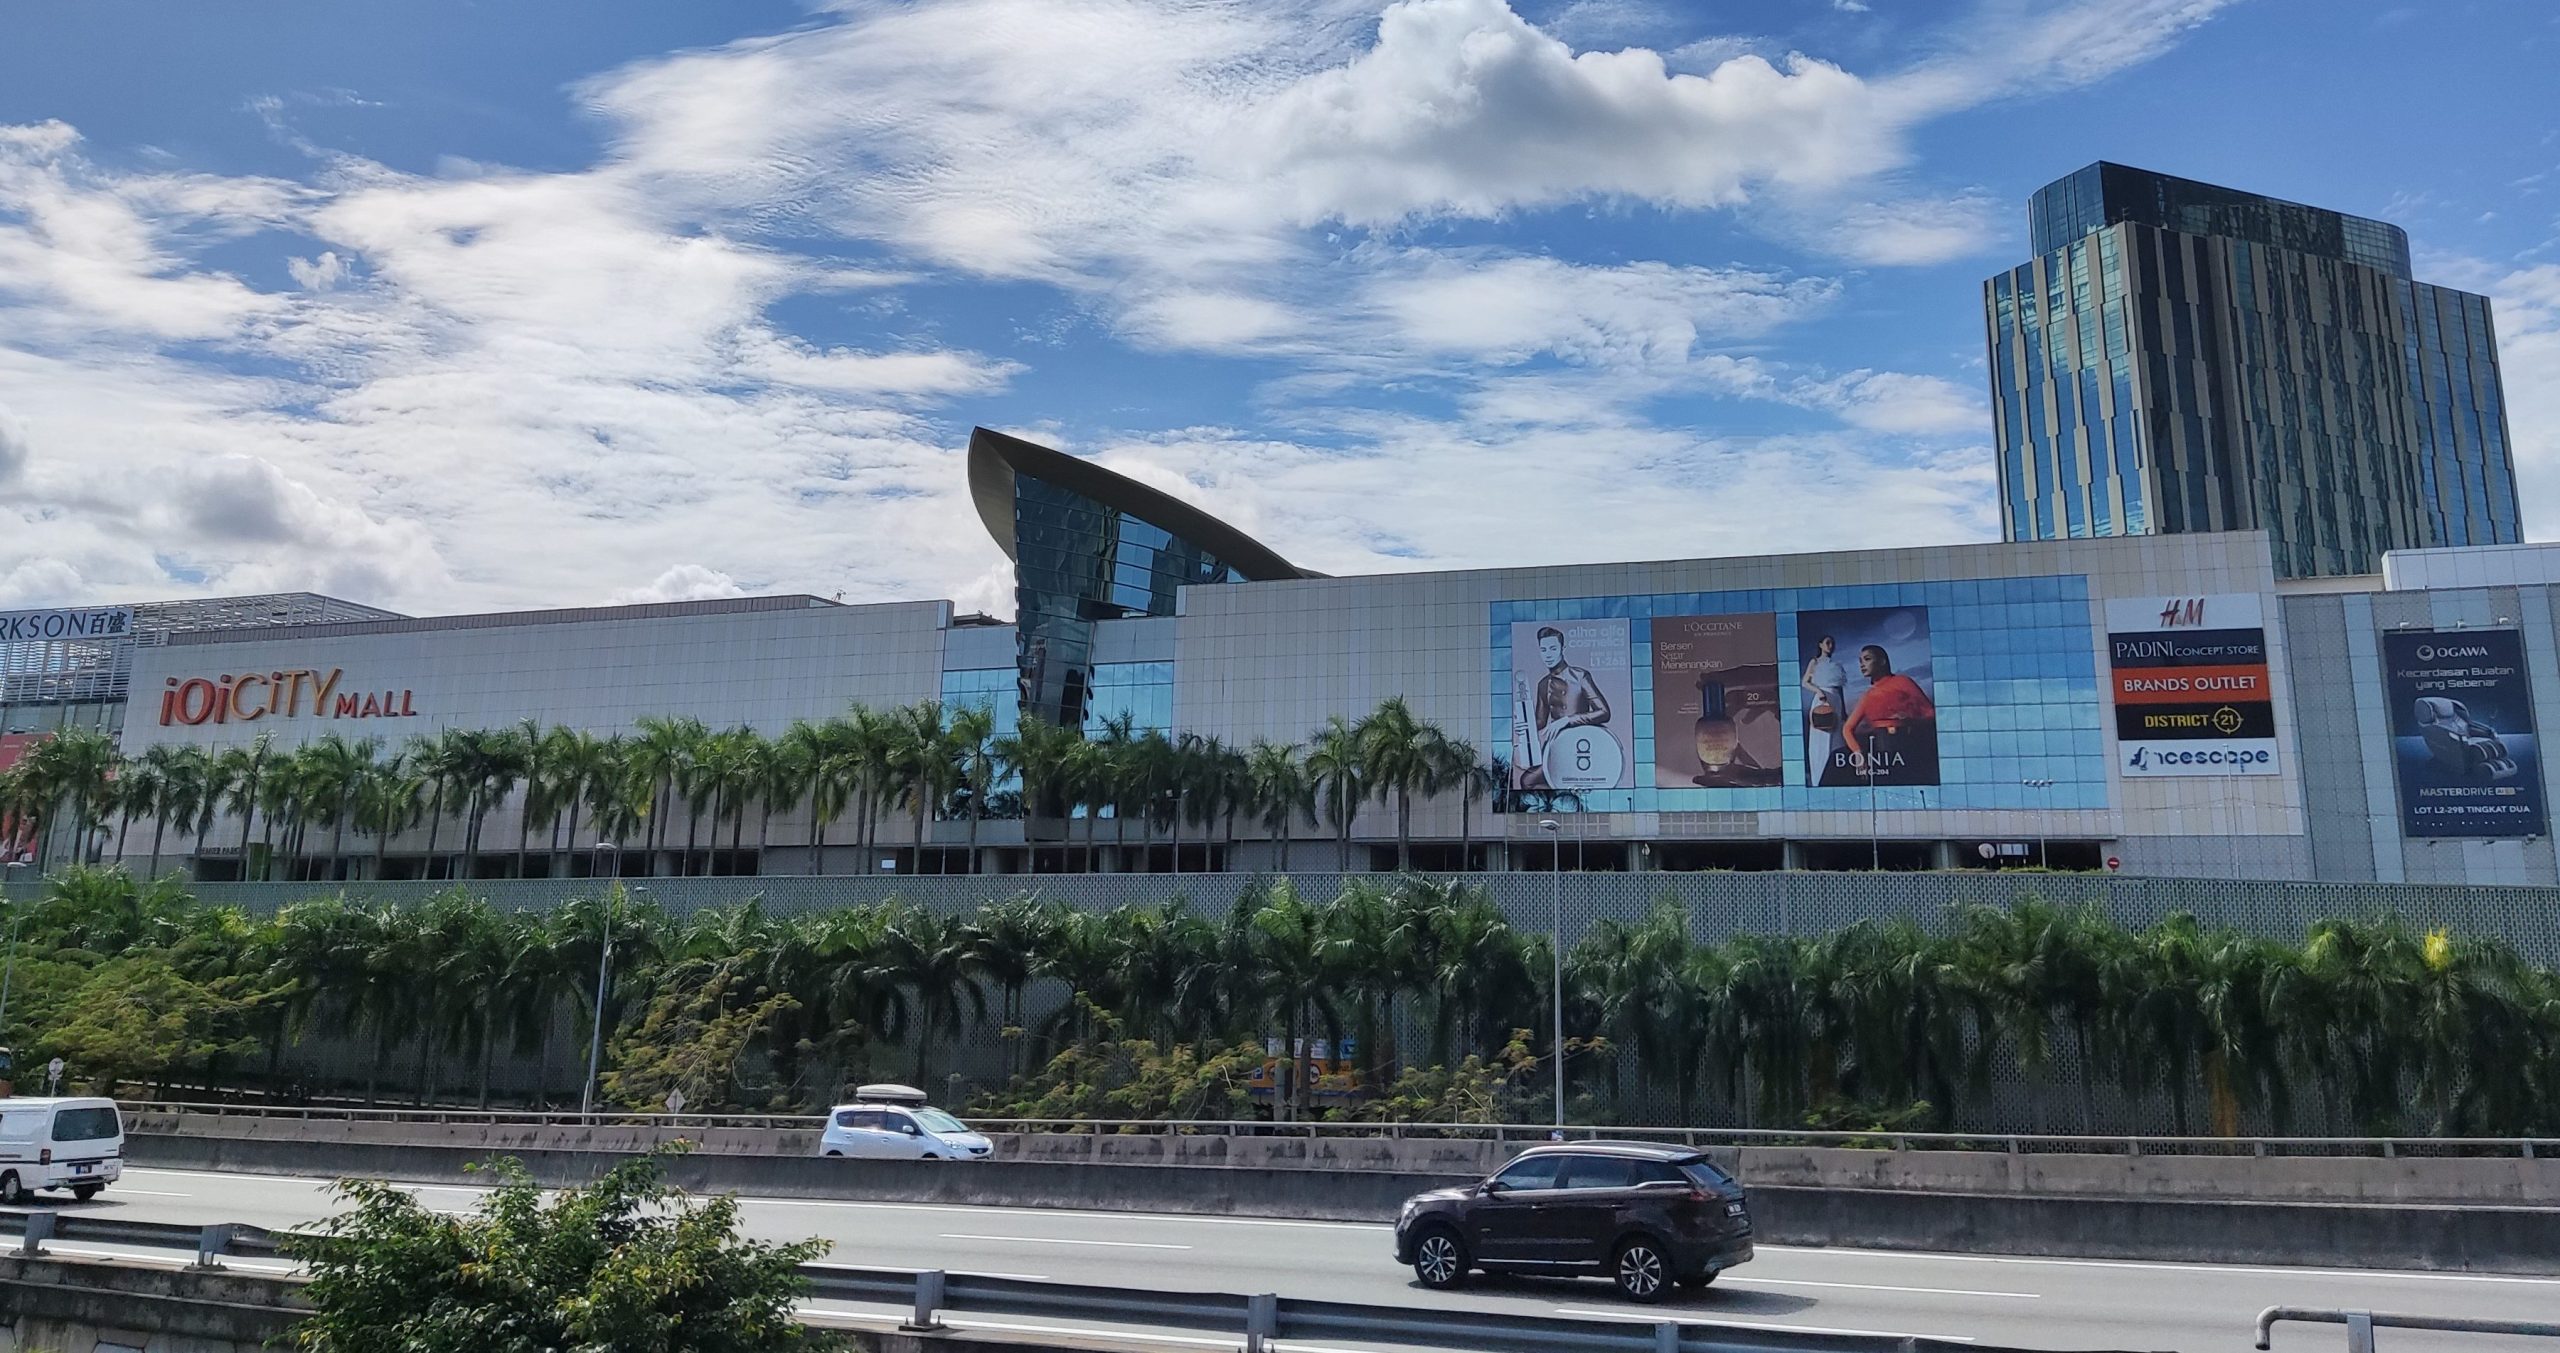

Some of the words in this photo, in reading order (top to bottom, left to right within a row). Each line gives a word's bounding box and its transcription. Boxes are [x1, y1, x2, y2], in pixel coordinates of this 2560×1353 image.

[2160, 598, 2205, 628] H&M
[90, 611, 127, 634] 百盛
[2116, 641, 2174, 659] PADINI
[2175, 646, 2224, 657] CONCEPT
[2227, 645, 2259, 655] STORE
[2437, 646, 2488, 658] OGAWA
[1661, 659, 1722, 671] Menenangkan
[2397, 668, 2469, 678] Kecerdasan
[2472, 666, 2514, 676] Buatan
[2124, 677, 2189, 692] BRANDS
[2194, 676, 2257, 690] OUTLET
[2415, 680, 2446, 691] yang
[2447, 678, 2498, 688] Sebenar
[333, 689, 417, 719] MALL
[2144, 714, 2209, 728] DISTRICT
[2220, 714, 2234, 726] 21
[1835, 751, 1905, 768] BONIA
[2420, 787, 2494, 797] MASTERDRIVE
[2414, 806, 2432, 815] LOT
[2434, 806, 2465, 814] L2-29B
[2466, 805, 2508, 813] TINGKAT
[2509, 805, 2531, 813] DUA
